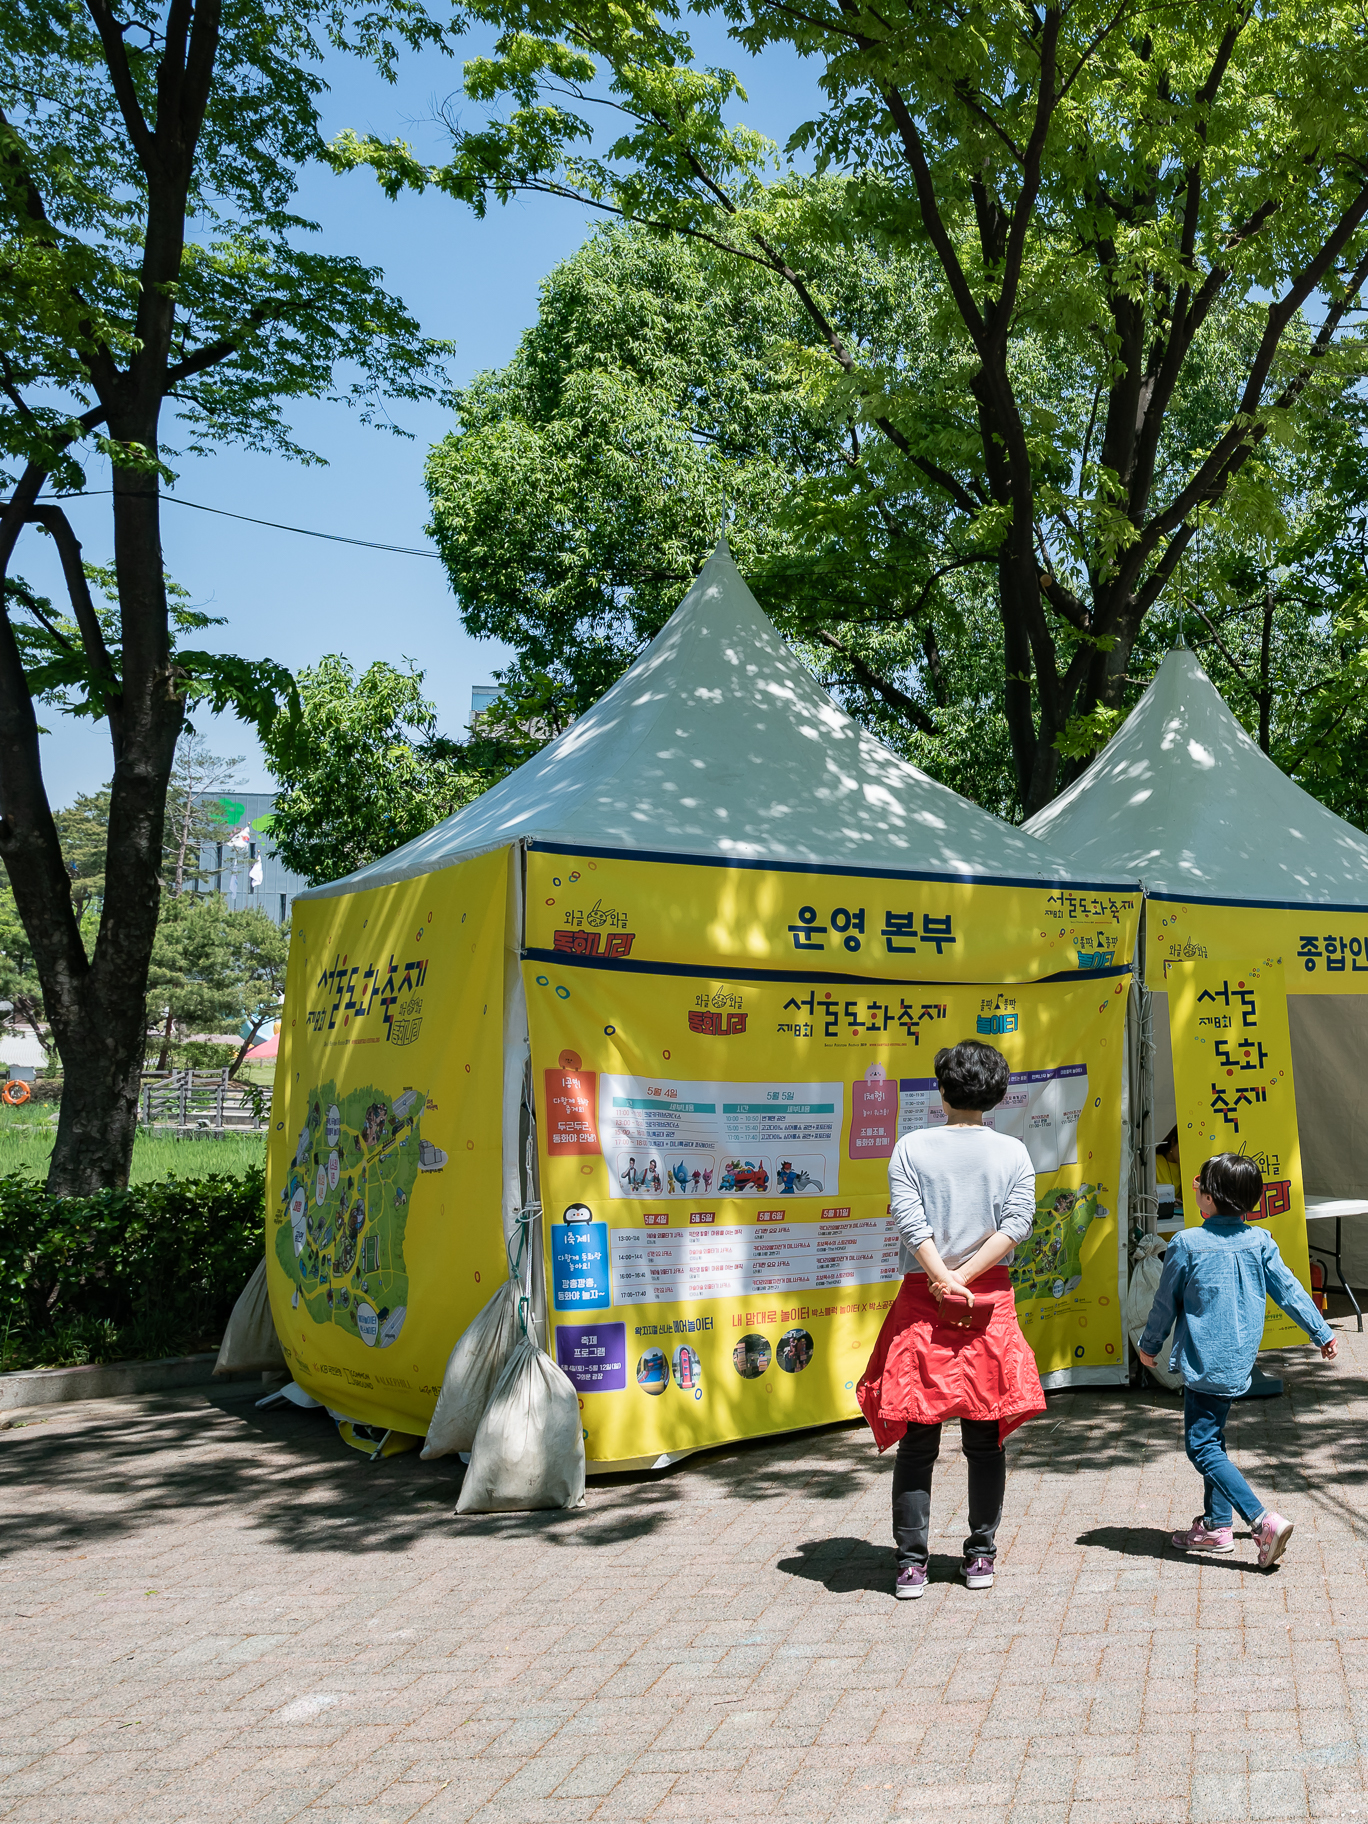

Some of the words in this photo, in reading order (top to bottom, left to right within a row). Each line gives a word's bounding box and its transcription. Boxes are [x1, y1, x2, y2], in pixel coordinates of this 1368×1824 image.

[1047, 891, 1134, 924] 서울동화축제
[564, 910, 584, 926] 와글
[609, 910, 628, 928] 와글
[787, 905, 866, 952] 운영
[881, 910, 957, 954] 본부
[317, 954, 429, 1041] 서울동화축제
[695, 994, 709, 1008] 와글
[728, 995, 743, 1009] 와글
[980, 998, 993, 1011] 폴짝
[1003, 997, 1016, 1011] 폴짝
[1197, 980, 1257, 1028] 서울
[688, 1010, 748, 1035] 동화나라
[783, 990, 947, 1046] 서울동화축제
[976, 1012, 1018, 1035] 놀이터
[1198, 1015, 1232, 1028] 제8회
[777, 1022, 813, 1037] 제8회
[1214, 1037, 1268, 1077] 동화
[647, 1087, 662, 1096] 5월
[664, 1089, 678, 1098] 4일
[766, 1091, 779, 1100] 5월
[781, 1091, 795, 1100] 5일
[669, 1104, 694, 1112] 세부내용
[736, 1105, 749, 1113] 시간
[786, 1105, 810, 1113] 세부내용
[1211, 1082, 1267, 1133] 축제
[558, 1121, 591, 1131] 두근두근,
[553, 1133, 577, 1143] 동화야
[1260, 1154, 1280, 1176] 와글
[701, 1214, 713, 1222] 5일
[759, 1212, 770, 1221] 5월
[771, 1212, 783, 1220] 6일
[823, 1209, 835, 1217] 5월
[836, 1208, 849, 1217] 11일
[656, 1215, 667, 1223] 4일
[558, 1253, 579, 1262] 다함께
[582, 1252, 602, 1261] 동화랑
[562, 1277, 597, 1288] 깡충깡충,
[558, 1290, 580, 1300] 동화야
[582, 1289, 605, 1300] 놀자~
[732, 1314, 742, 1327] 내
[745, 1310, 777, 1327] 맘대로
[780, 1307, 810, 1322] 놀이터
[811, 1306, 838, 1317] 박스블럭
[840, 1304, 860, 1314] 놀이터
[861, 1303, 868, 1312] X
[659, 1324, 673, 1334] 신나는
[581, 1336, 597, 1345] 축제
[574, 1347, 606, 1357] 프로그램
